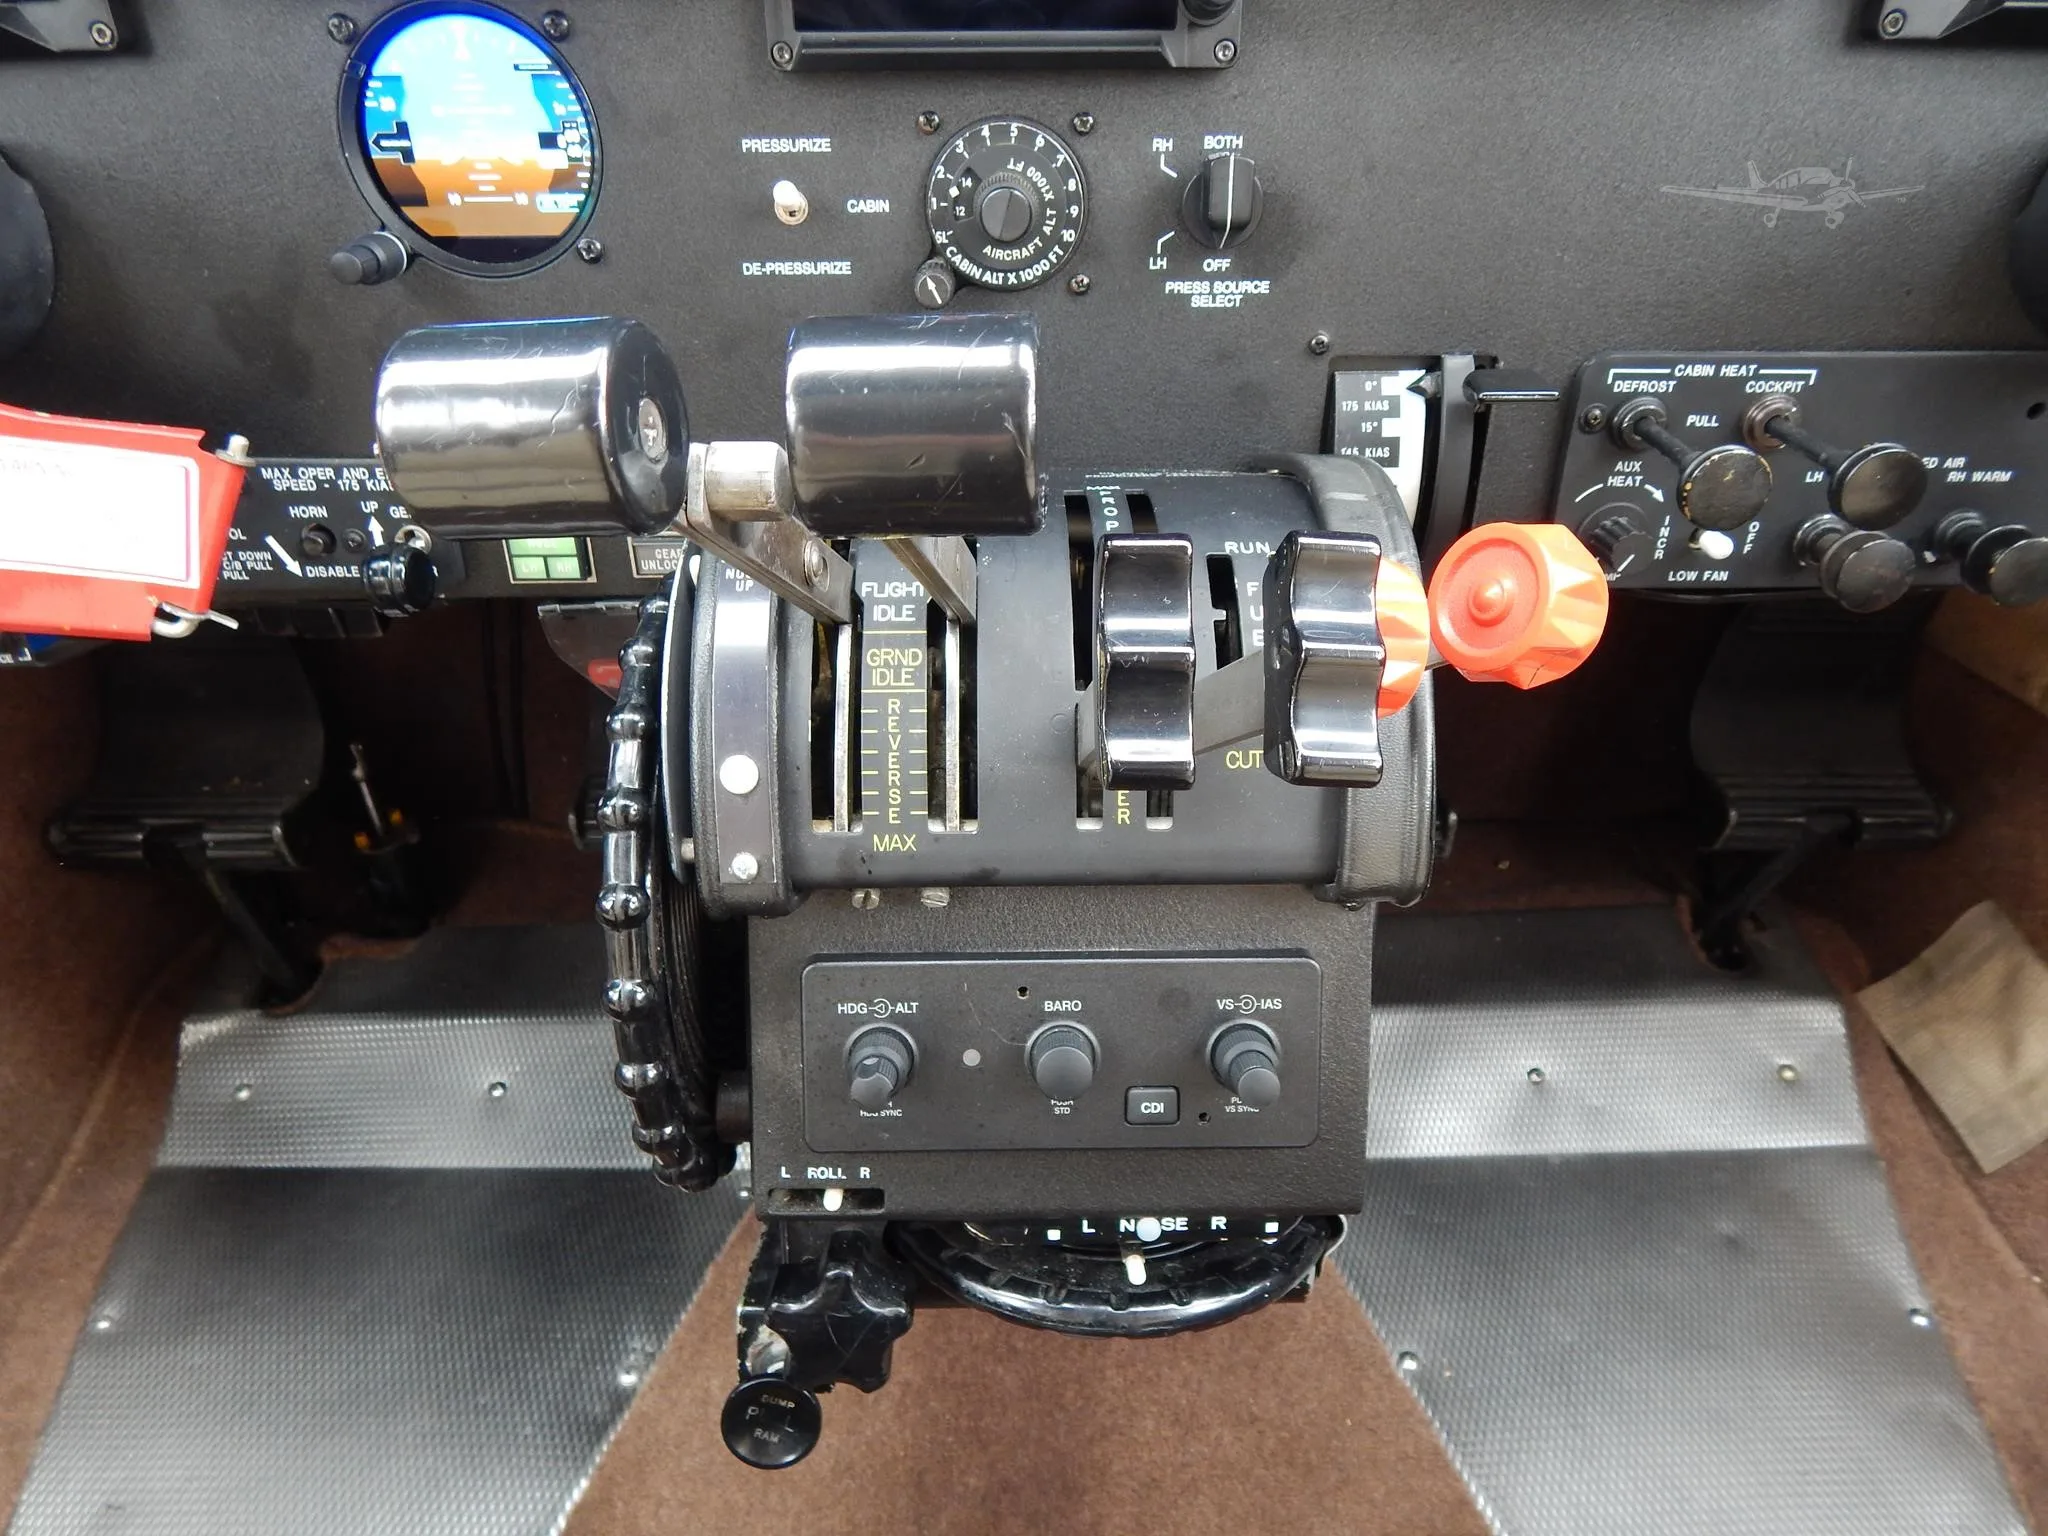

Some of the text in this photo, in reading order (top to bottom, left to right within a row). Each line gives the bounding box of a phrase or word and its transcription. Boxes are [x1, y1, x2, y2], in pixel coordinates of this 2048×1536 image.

[981, 124, 990, 138] 4
[1010, 124, 1018, 138] 5
[741, 138, 832, 153] PRESSURIZE
[955, 140, 964, 154] 3
[1036, 134, 1045, 148] 6
[1152, 137, 1174, 152] RH
[1203, 134, 1243, 150] BOTH
[1006, 157, 1025, 173] FT
[1056, 154, 1065, 168] 7
[936, 165, 945, 179] 2
[961, 177, 973, 188] 14
[1068, 178, 1077, 192] 8
[847, 199, 890, 214] CABIN
[931, 197, 937, 210] 1
[956, 206, 966, 217] 12
[1070, 205, 1080, 218] 9
[1043, 208, 1057, 236] ALT
[1061, 229, 1076, 243] 10
[982, 236, 1043, 261] AIRCRAFT
[742, 261, 852, 275] DE-PRESSURIZE
[946, 244, 1065, 285] CABIN ALT X 1000 FT
[1149, 256, 1167, 270] LH
[1202, 258, 1232, 272] OFF
[1164, 280, 1270, 294] PRESS SOURCE
[1190, 294, 1243, 308] SELECT
[1674, 364, 1758, 377] CABIN HEAT
[1613, 380, 1677, 393] DEFROST
[1745, 380, 1805, 393] COCKPIT
[1342, 400, 1390, 411] 175 KIAS
[1686, 414, 1720, 427] PULL
[1365, 446, 1390, 458] KIAS
[1614, 461, 1642, 472] AUX
[1943, 457, 1966, 469] AIR
[261, 467, 290, 480] MAX
[299, 467, 335, 481] OPER
[343, 467, 369, 480] AND
[1805, 471, 1824, 483] LH
[1947, 471, 2013, 482] RH WARM
[273, 479, 317, 492] SPEED
[337, 480, 360, 492] 175
[367, 479, 395, 492] KIA
[1607, 476, 1643, 487] HEAT
[289, 505, 329, 518] HORN
[360, 500, 379, 514] UP
[1653, 515, 1671, 561] INCR
[1742, 521, 1760, 555] OFF
[1224, 541, 1270, 555] RUN
[238, 551, 272, 561] DOWN
[246, 561, 273, 571] PULL
[306, 565, 361, 578] DISABLE
[641, 560, 677, 570] UNLOC
[223, 570, 250, 580] PULL
[1668, 570, 1728, 582] LOW FAN
[735, 580, 754, 592] UP
[861, 581, 925, 598] FLIGHT
[872, 605, 916, 622] IDLE
[866, 648, 923, 667] GRND
[872, 668, 915, 687] IDLE
[887, 698, 902, 825] REVERSE
[1225, 750, 1265, 769] CUT
[873, 834, 917, 852] MAX
[838, 1002, 919, 1015] HDG ALT
[1044, 1000, 1082, 1012] BARO
[1216, 998, 1282, 1010] VS IAS
[880, 1109, 903, 1117] SYNC
[1054, 1106, 1071, 1115] STD
[1141, 1102, 1165, 1114] CDI
[1224, 1105, 1236, 1113] VS
[781, 1166, 871, 1180] L ROLL R
[1082, 1219, 1096, 1233] L
[1210, 1216, 1228, 1231] R
